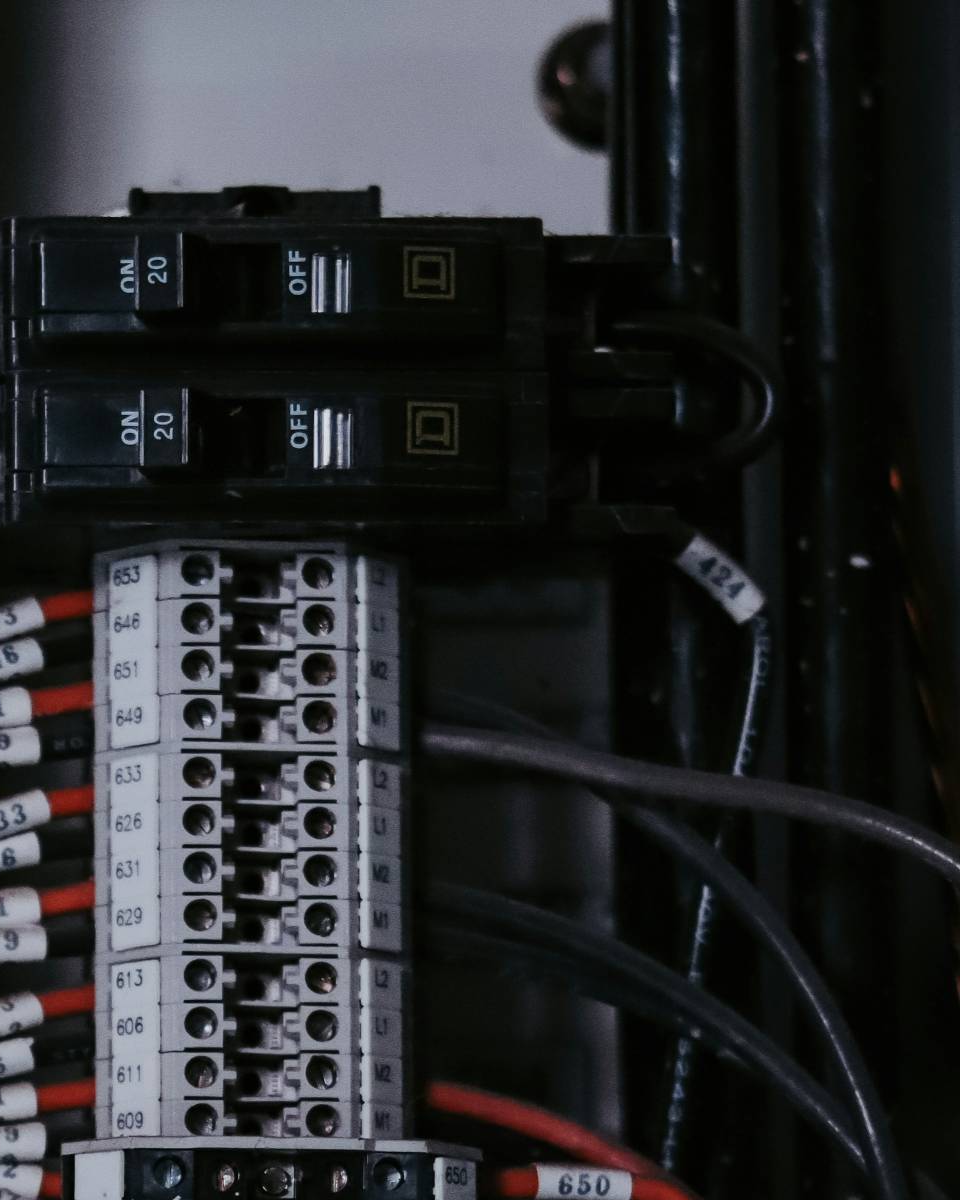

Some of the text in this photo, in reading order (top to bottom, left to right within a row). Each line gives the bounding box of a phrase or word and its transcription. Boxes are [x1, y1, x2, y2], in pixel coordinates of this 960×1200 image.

[120, 259, 135, 294] ON
[148, 256, 167, 284] 20
[288, 251, 307, 296] OFF
[121, 410, 139, 446] ON
[154, 412, 174, 441] 20
[290, 403, 308, 449] OFF
[114, 612, 140, 632] 646
[114, 661, 139, 680] 651
[116, 707, 142, 726] 649
[116, 765, 142, 784] 633
[115, 813, 142, 832] 626
[116, 860, 140, 879] 631
[116, 908, 142, 926] 629
[116, 971, 143, 989] 613
[117, 1017, 144, 1035] 606
[117, 1066, 142, 1083] 611
[117, 1112, 144, 1130] 609
[446, 1167, 467, 1186] 650
[559, 1174, 610, 1196] 650
